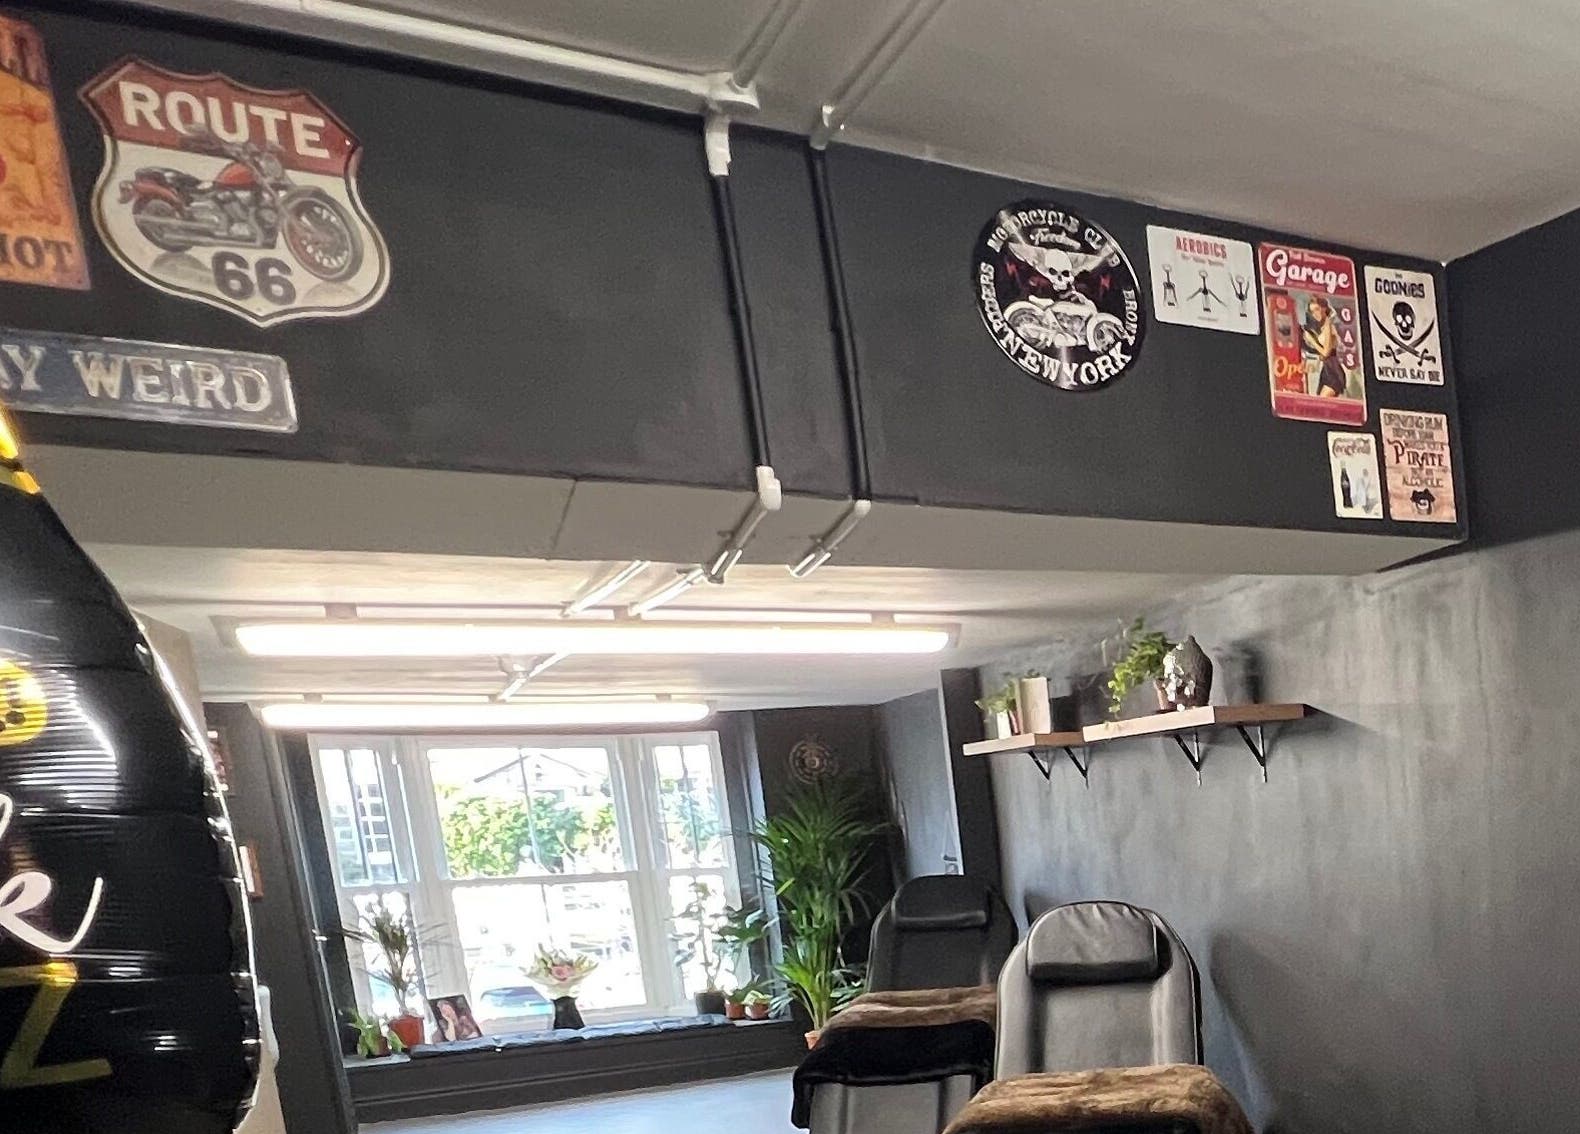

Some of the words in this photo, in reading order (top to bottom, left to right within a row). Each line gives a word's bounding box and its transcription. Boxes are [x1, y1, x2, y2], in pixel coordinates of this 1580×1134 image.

[118, 81, 332, 159] ROUTE
[1176, 236, 1227, 259] AEROBICS
[1266, 249, 1350, 294] Garage
[212, 251, 297, 305] 66
[72, 350, 273, 413] WEIRD
[999, 332, 1062, 383] NEW
[1063, 341, 1133, 387] YORK
[1378, 366, 1408, 379] NEVER
[1410, 369, 1426, 381] SAY
